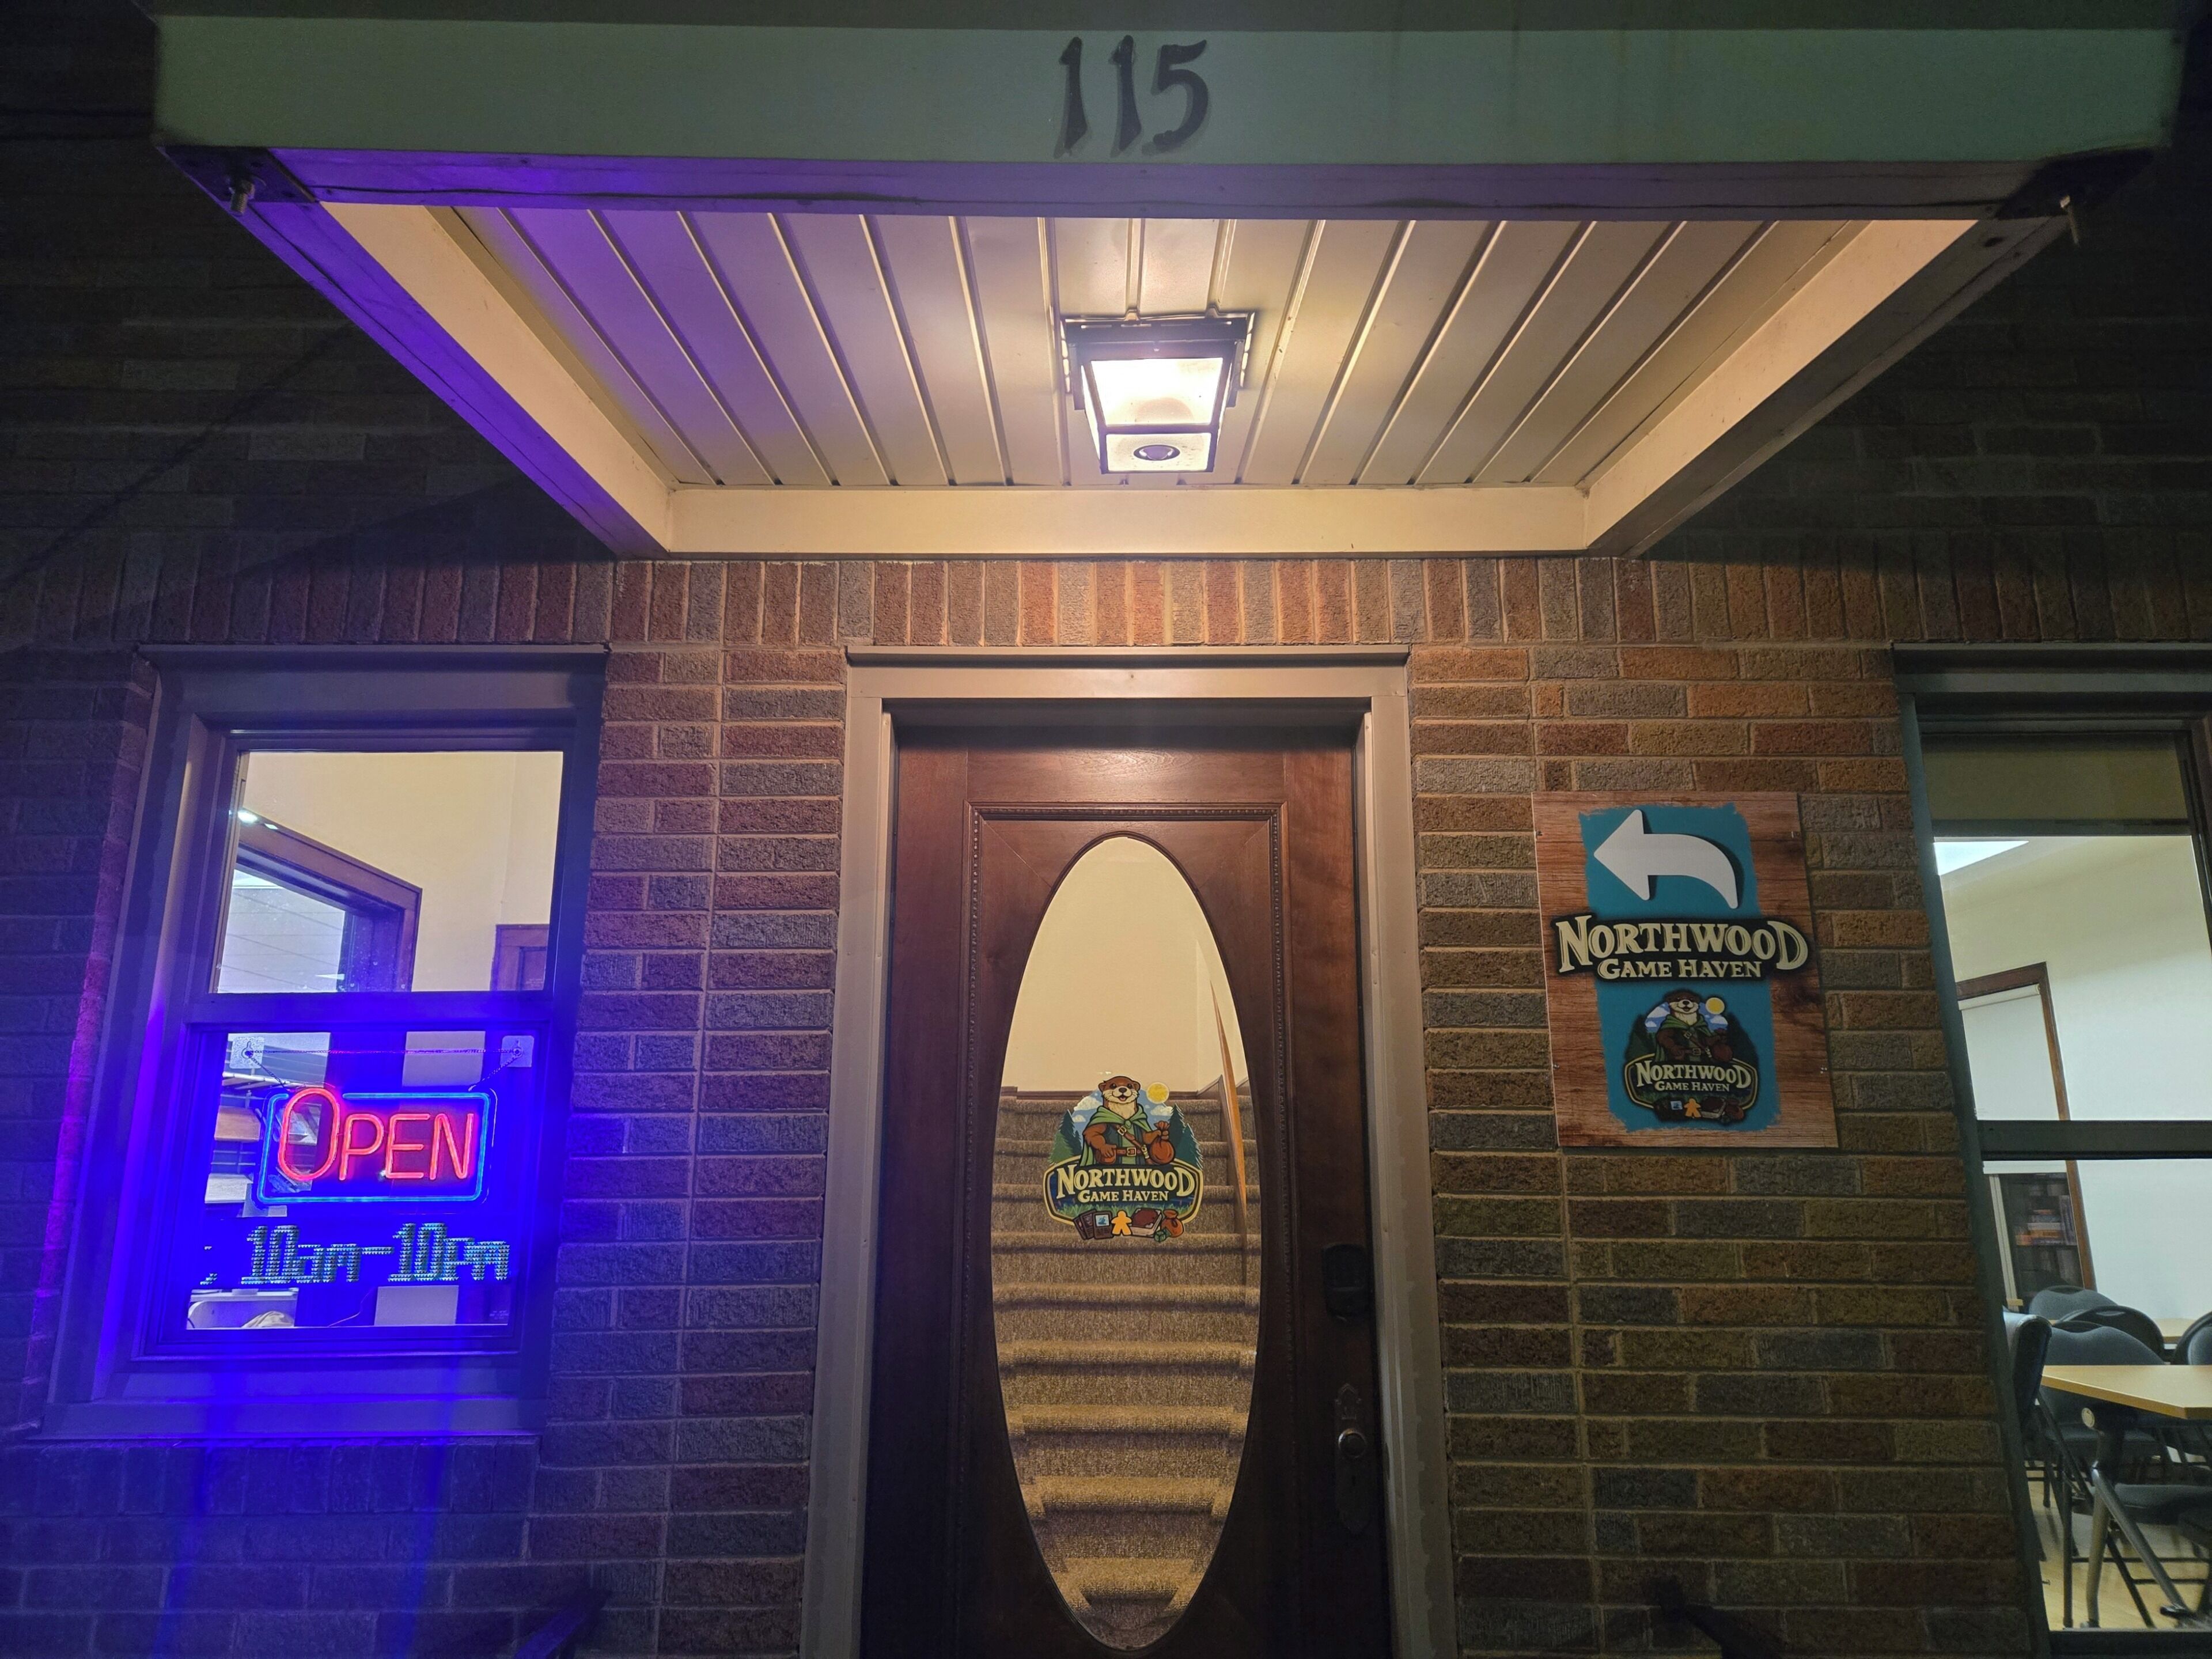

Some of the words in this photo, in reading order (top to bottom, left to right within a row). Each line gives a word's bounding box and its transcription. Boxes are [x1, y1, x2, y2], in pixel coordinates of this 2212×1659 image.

[1058, 35, 1209, 156] 115
[1556, 915, 1808, 972] NORTHWOOD
[1596, 959, 1672, 979] GAME
[1678, 959, 1762, 978] HAVEN
[1635, 1062, 1751, 1089] NORTHWOOD
[1654, 1081, 1689, 1092] GAME
[1692, 1081, 1730, 1092] HAVEN
[277, 1088, 475, 1181] OPEN
[1056, 1164, 1195, 1199] NORTHWOOD
[1077, 1190, 1119, 1202] GAME
[1122, 1190, 1169, 1202] HAVEN
